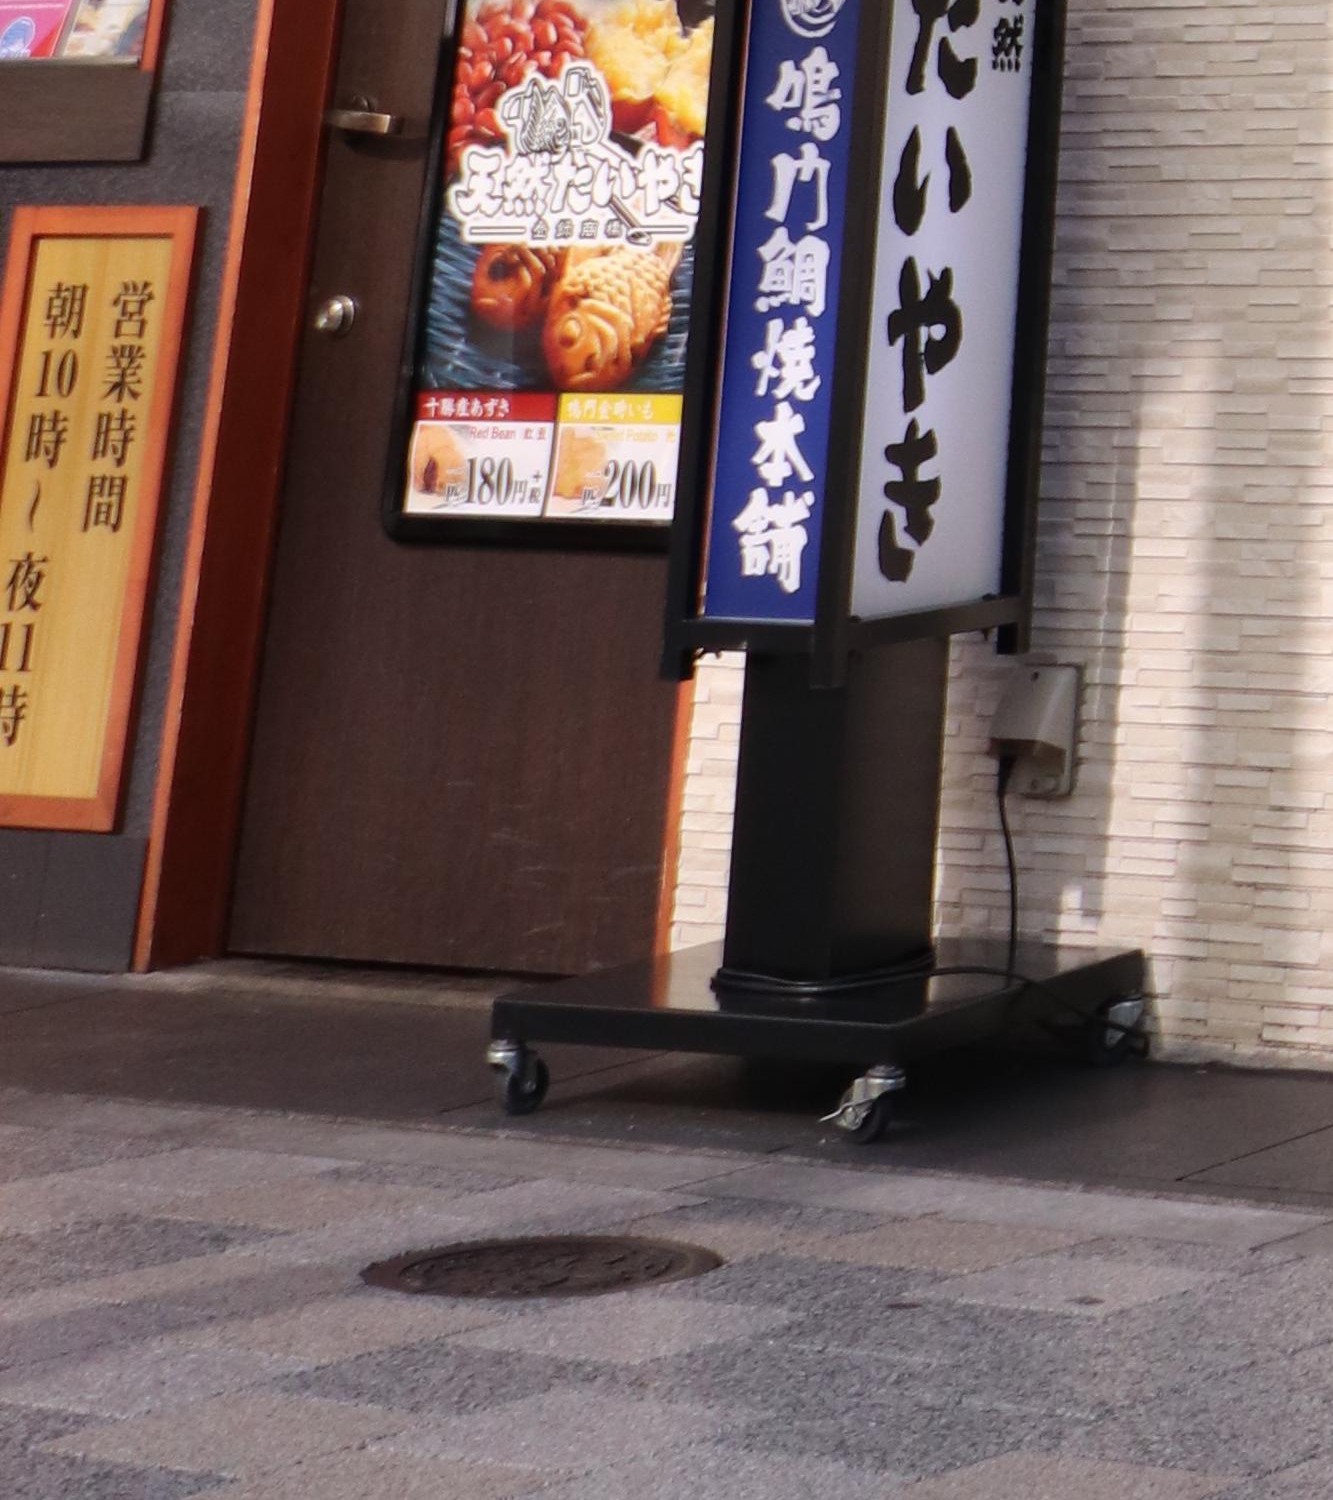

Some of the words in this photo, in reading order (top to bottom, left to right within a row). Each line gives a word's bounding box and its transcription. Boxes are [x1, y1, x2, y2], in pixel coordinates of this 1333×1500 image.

[80, 279, 156, 534] 営業時間
[424, 396, 511, 419] 十勝産あずき
[469, 426, 490, 440] Red
[491, 427, 517, 440] Bean
